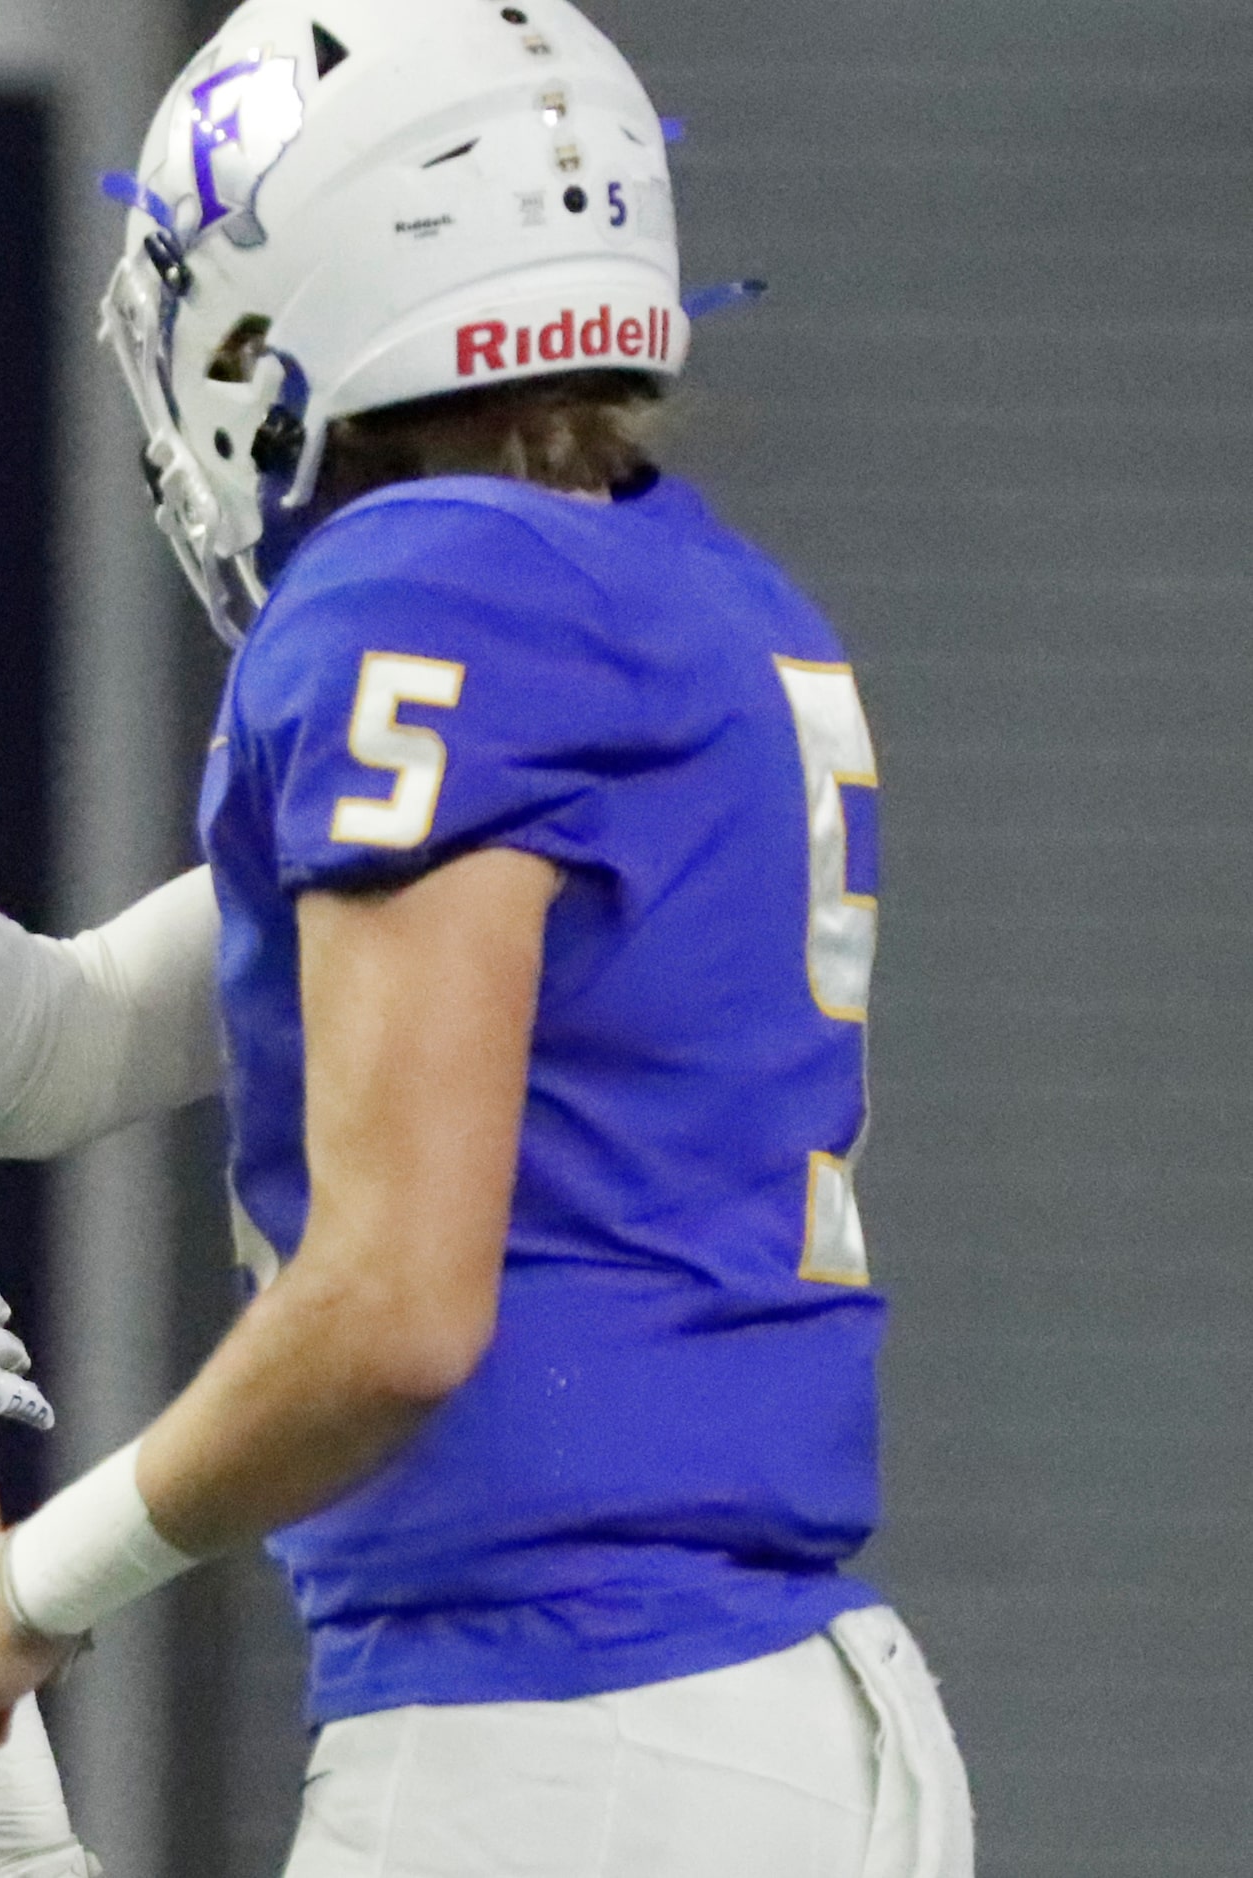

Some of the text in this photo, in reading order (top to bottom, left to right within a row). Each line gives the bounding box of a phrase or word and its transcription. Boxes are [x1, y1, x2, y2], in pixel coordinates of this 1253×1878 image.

[191, 48, 266, 230] F
[607, 181, 627, 227] 5
[456, 303, 671, 377] Riddell
[330, 650, 466, 848] 5
